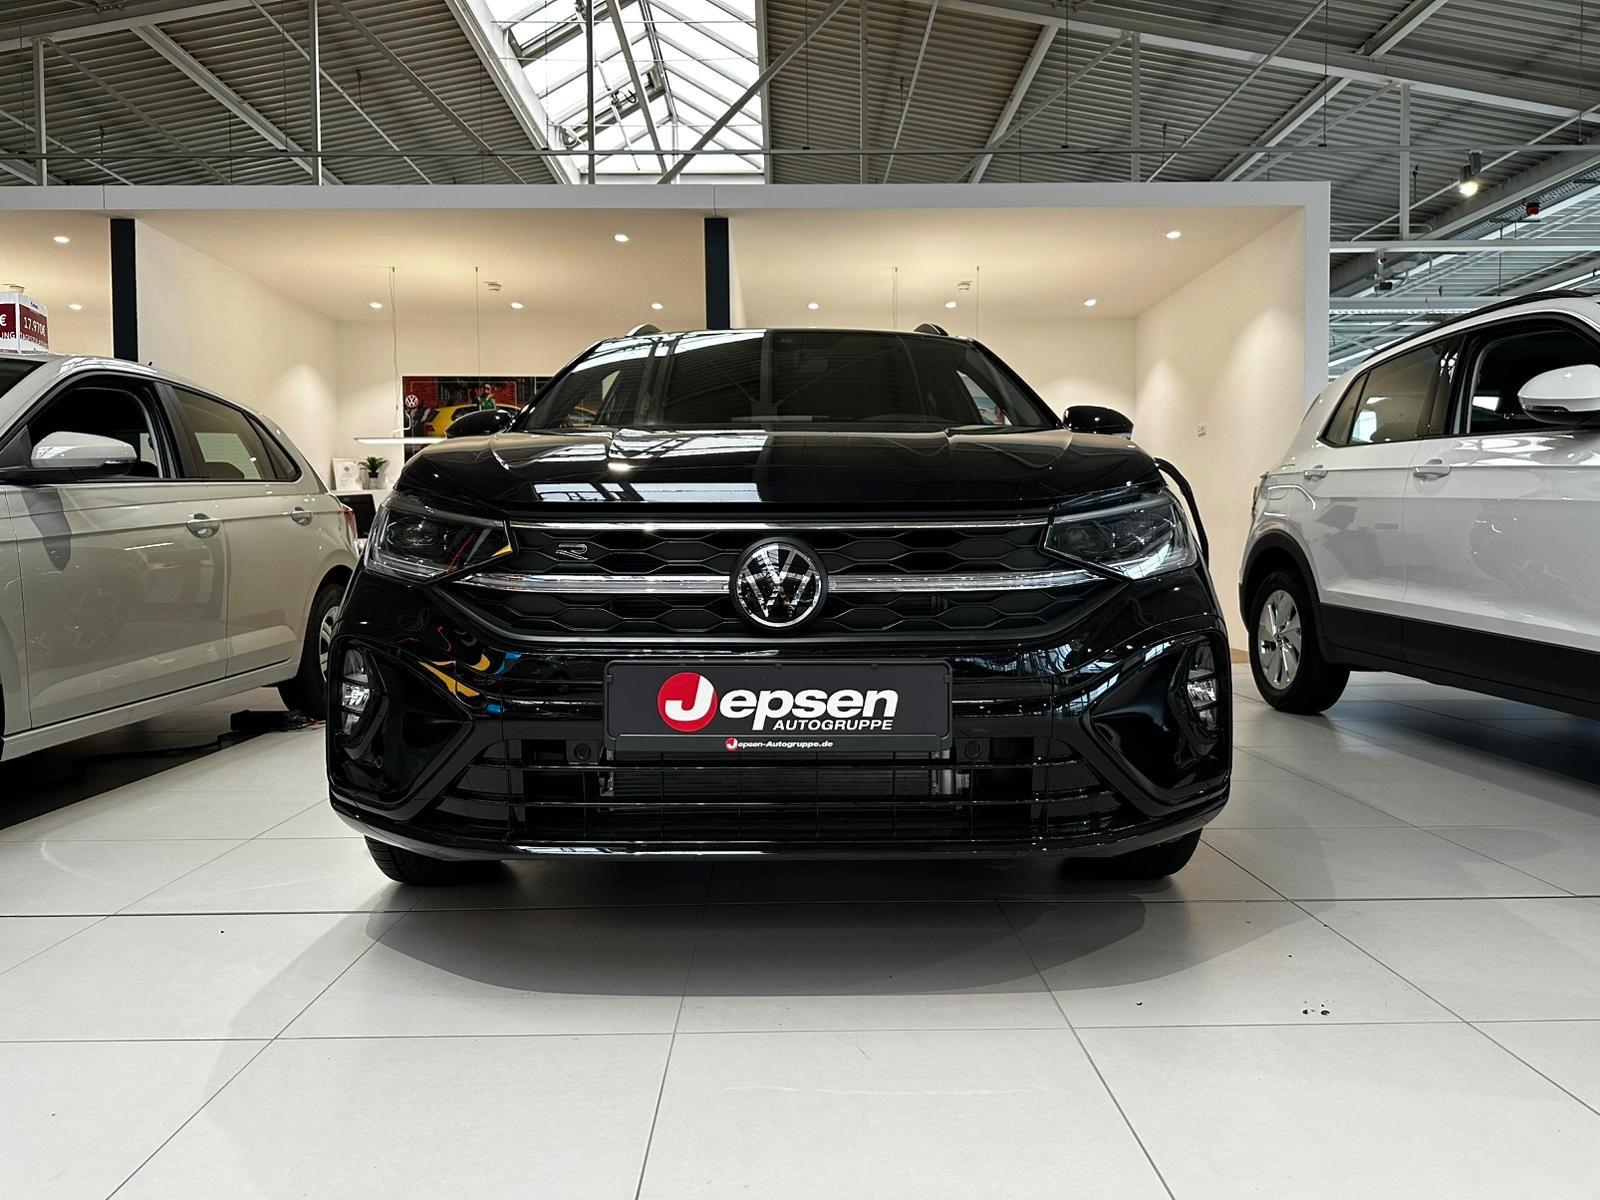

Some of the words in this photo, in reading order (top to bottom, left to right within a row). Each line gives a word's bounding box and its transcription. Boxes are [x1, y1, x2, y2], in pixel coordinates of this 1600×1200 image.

[737, 543, 822, 627] VW
[663, 674, 899, 731] Jepsen
[772, 719, 894, 732] AUTOGRUPPE
[726, 738, 834, 749] Jepsen-Autogruppe.de
